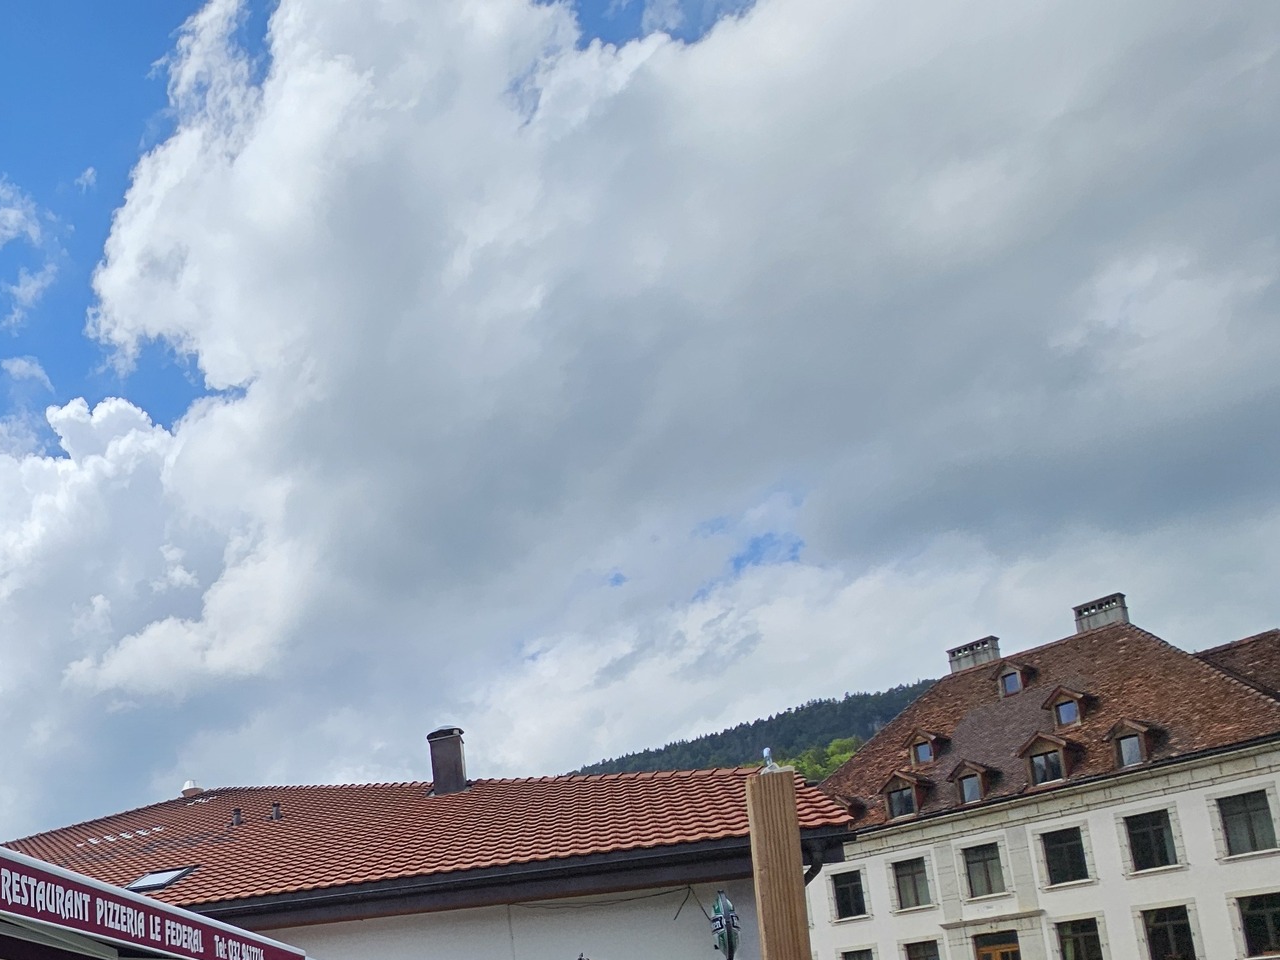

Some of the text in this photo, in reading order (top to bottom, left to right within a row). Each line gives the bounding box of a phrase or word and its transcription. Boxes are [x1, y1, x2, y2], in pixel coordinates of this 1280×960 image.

[1, 868, 90, 921] RESTAURANT
[96, 897, 145, 938] PIZZERIA
[149, 914, 162, 942] LE
[165, 919, 204, 953] FEDERAL
[213, 935, 227, 959] Tel:
